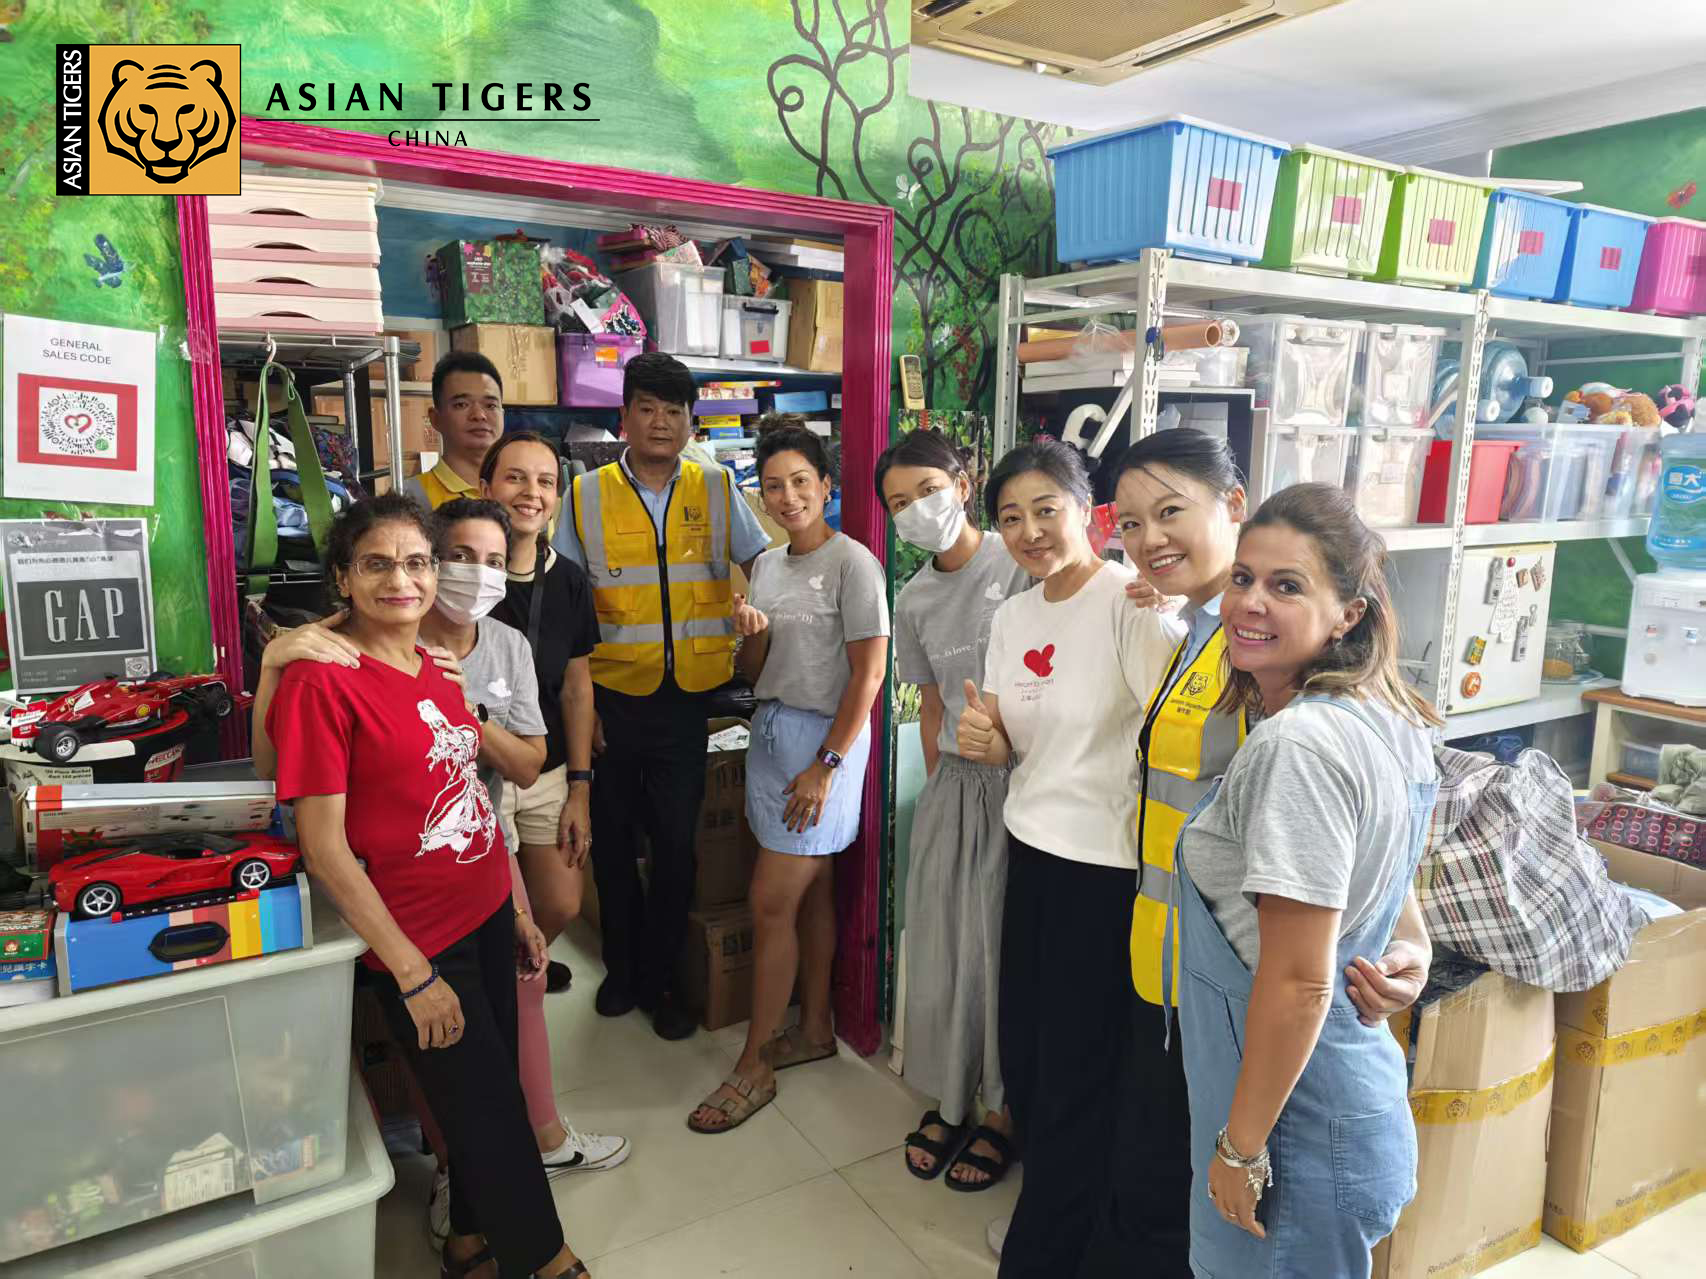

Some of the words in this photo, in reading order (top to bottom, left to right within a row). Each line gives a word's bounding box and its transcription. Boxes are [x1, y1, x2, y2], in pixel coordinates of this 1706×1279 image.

[49, 336, 103, 352] GENERAL
[42, 348, 77, 361] SALES
[79, 352, 113, 365] CODE
[44, 586, 124, 643] GAP
